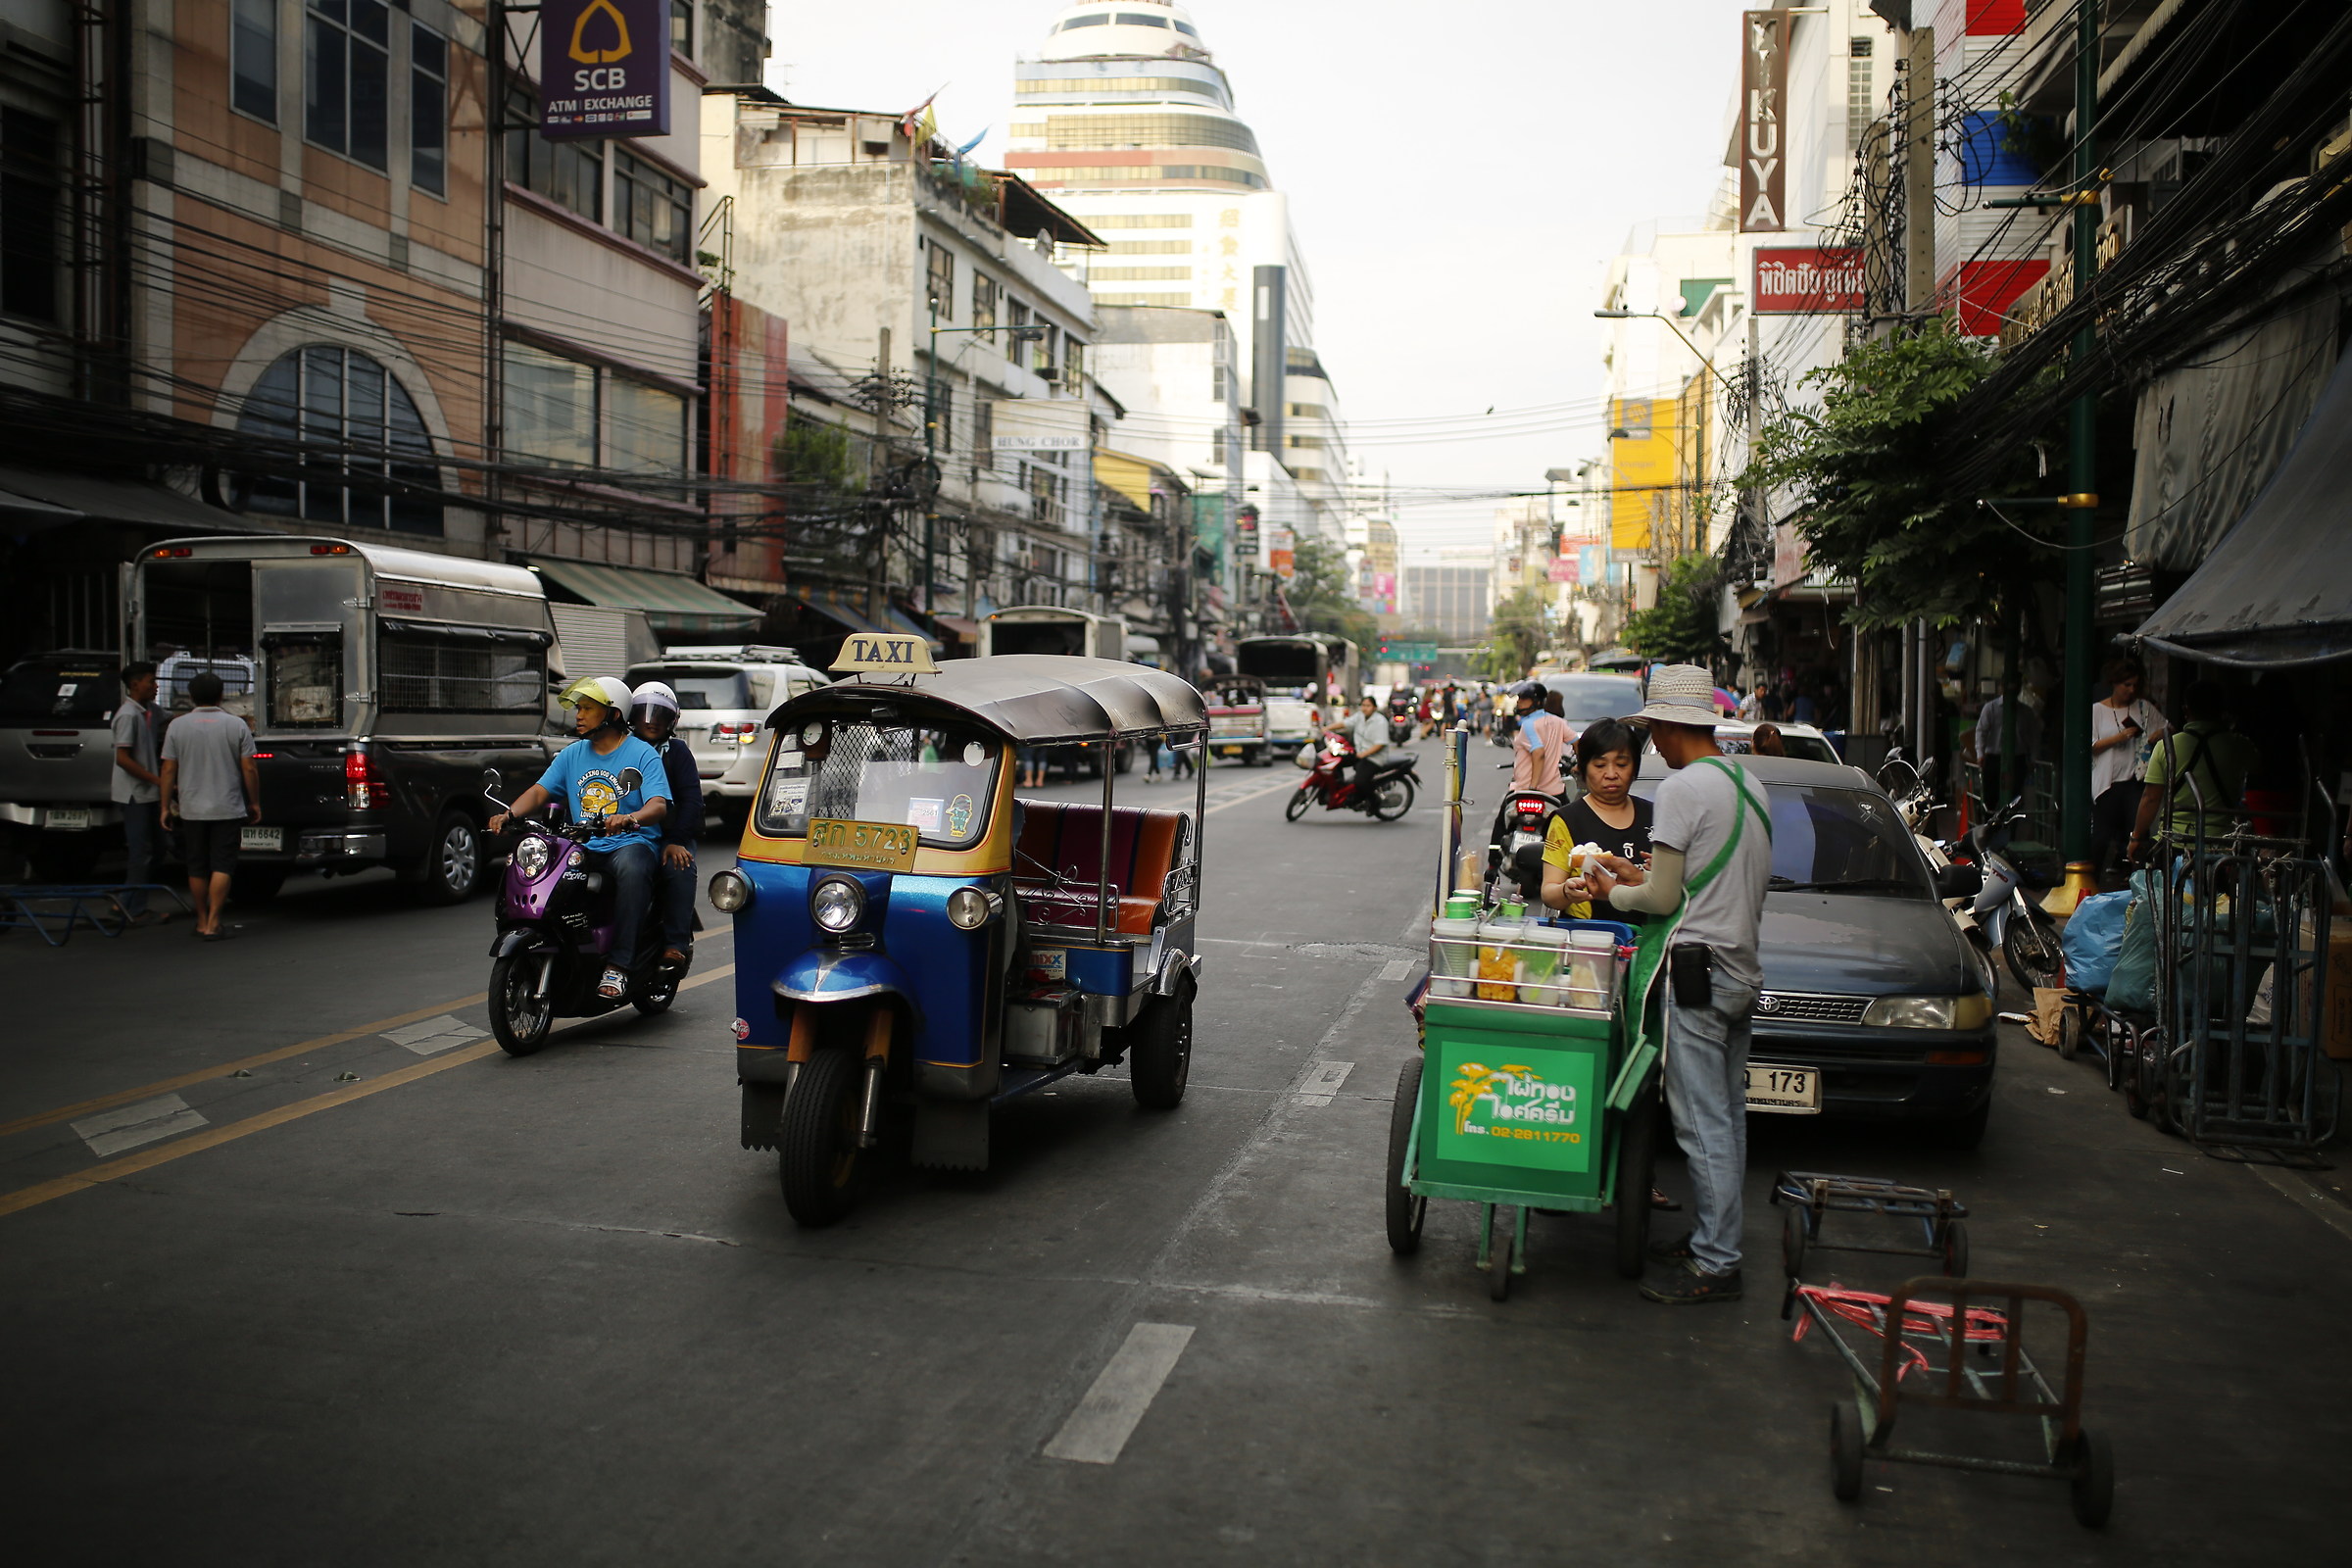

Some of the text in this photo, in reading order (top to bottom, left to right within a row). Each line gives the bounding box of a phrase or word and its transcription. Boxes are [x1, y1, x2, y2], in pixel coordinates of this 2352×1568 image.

[573, 67, 627, 92] SCB
[548, 95, 653, 113] ATM EXCHANGE
[997, 436, 1035, 448] HUNG
[851, 639, 915, 663] TAXI
[577, 769, 600, 787] MAKING
[609, 773, 624, 796] KNOWN
[258, 829, 280, 840] 6642
[854, 824, 912, 855] 5723
[563, 871, 587, 881] FINO
[1768, 1071, 1806, 1094] 173
[1491, 1125, 1581, 1145] 02-2811770
